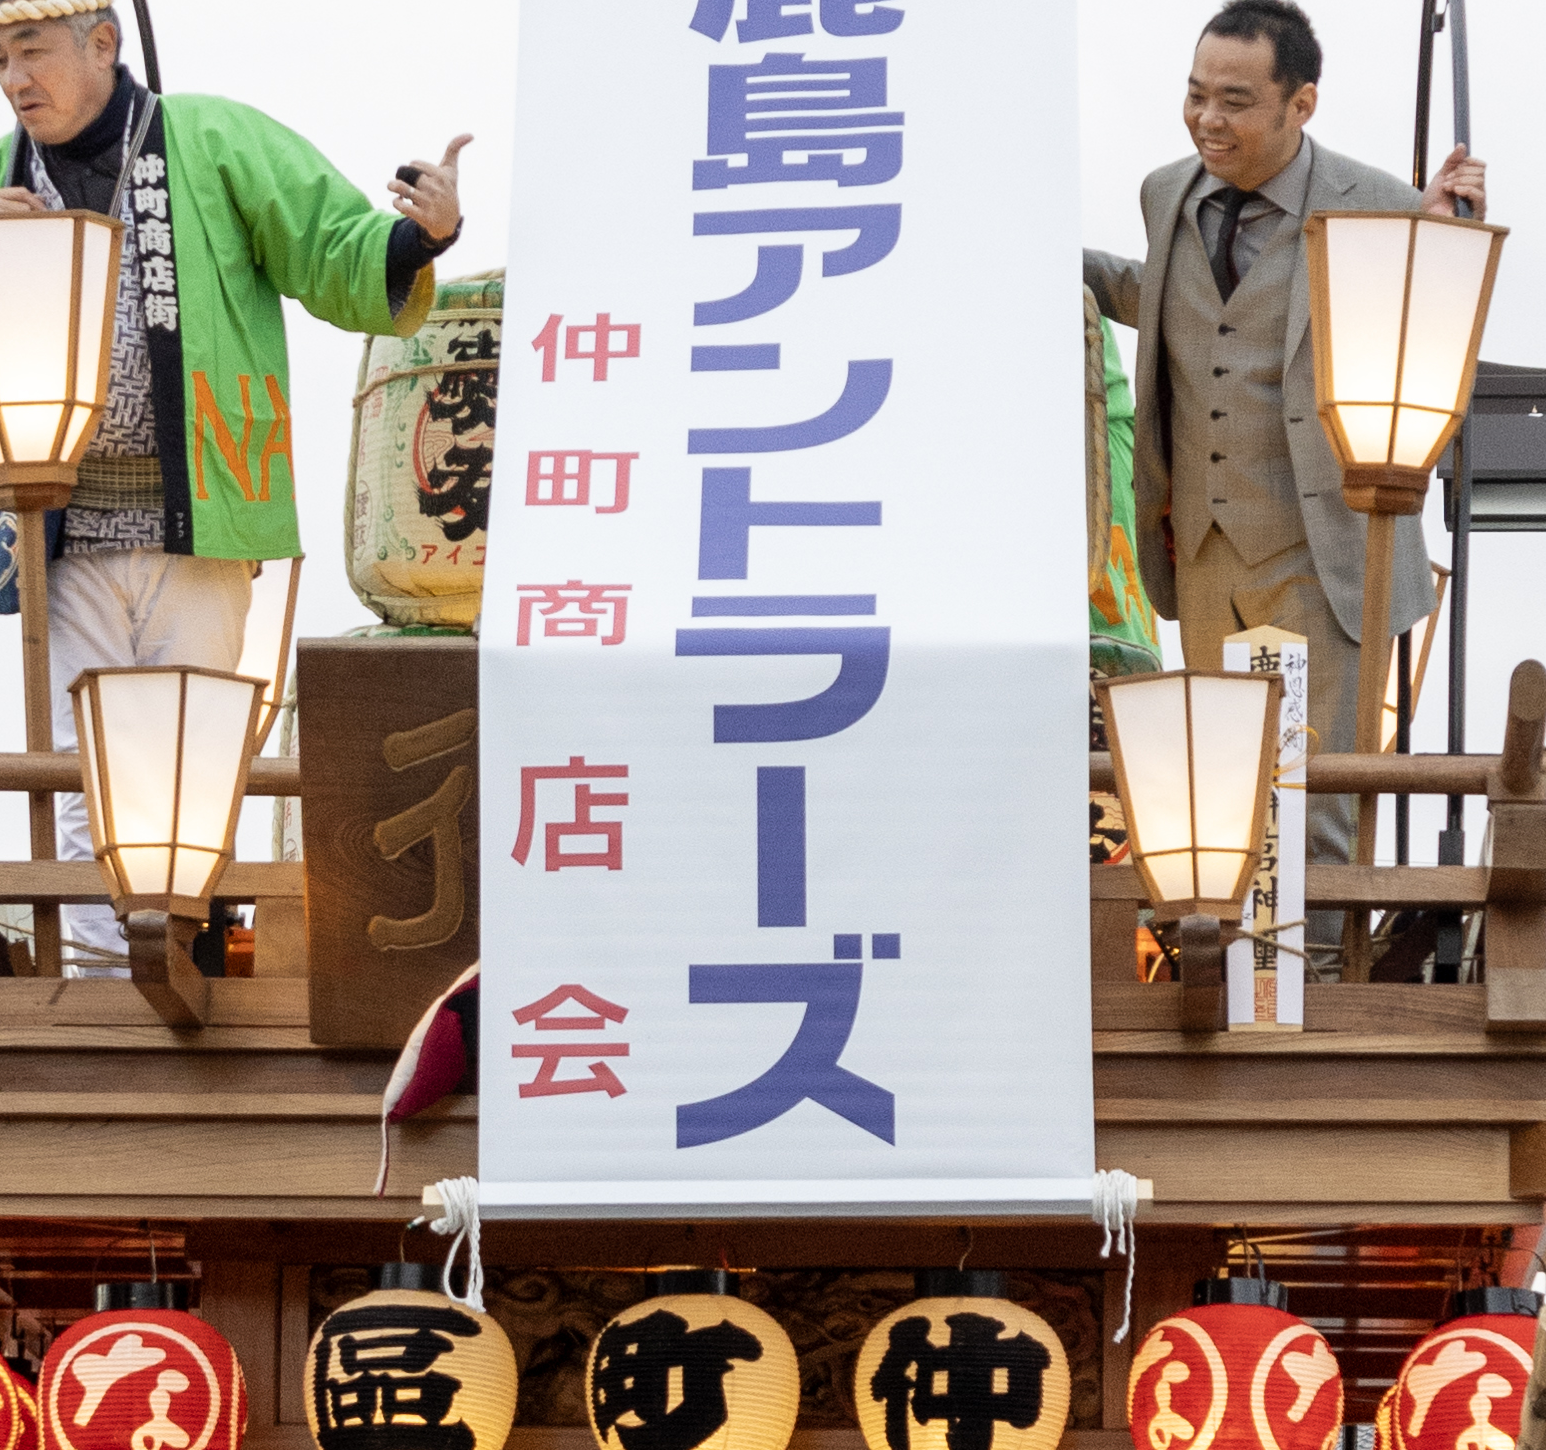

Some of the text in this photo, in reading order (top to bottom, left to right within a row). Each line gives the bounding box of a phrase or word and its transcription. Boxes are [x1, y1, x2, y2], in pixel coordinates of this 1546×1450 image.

[133, 153, 178, 331] 仲町商店街
[511, 313, 641, 1099] 仲町商店会
